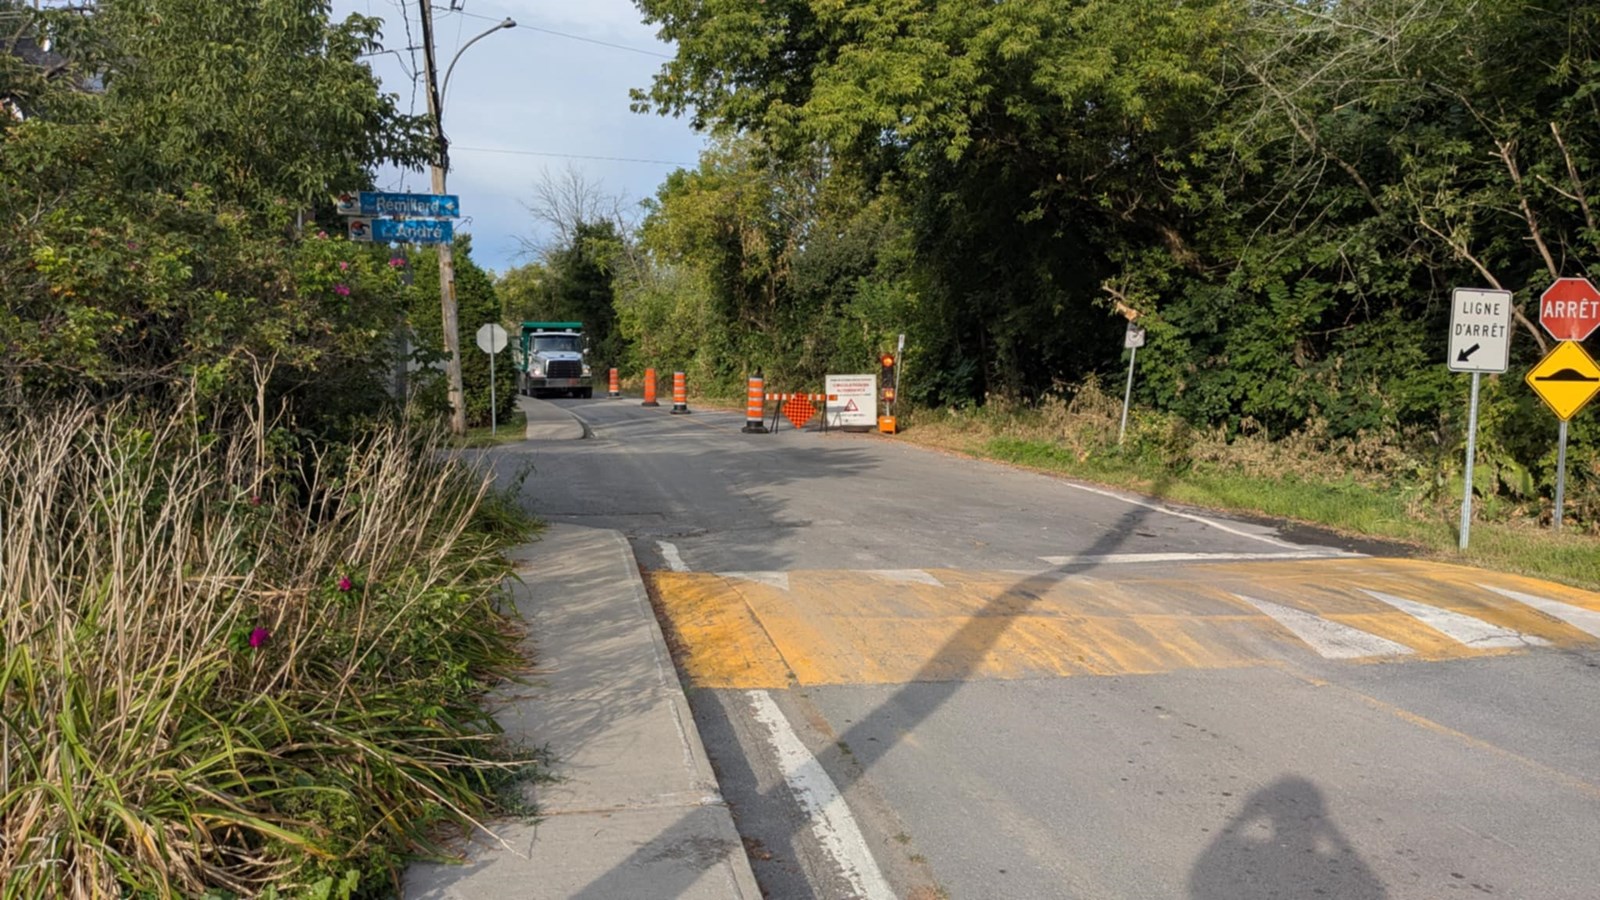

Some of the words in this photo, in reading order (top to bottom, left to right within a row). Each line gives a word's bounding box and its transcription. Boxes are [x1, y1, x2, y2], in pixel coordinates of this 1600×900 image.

[376, 195, 439, 212] Rémillard
[395, 222, 443, 238] André
[1463, 302, 1500, 315] LIGNE
[1543, 298, 1599, 318] ARRÊT
[1455, 323, 1505, 338] D'ARRÊT
